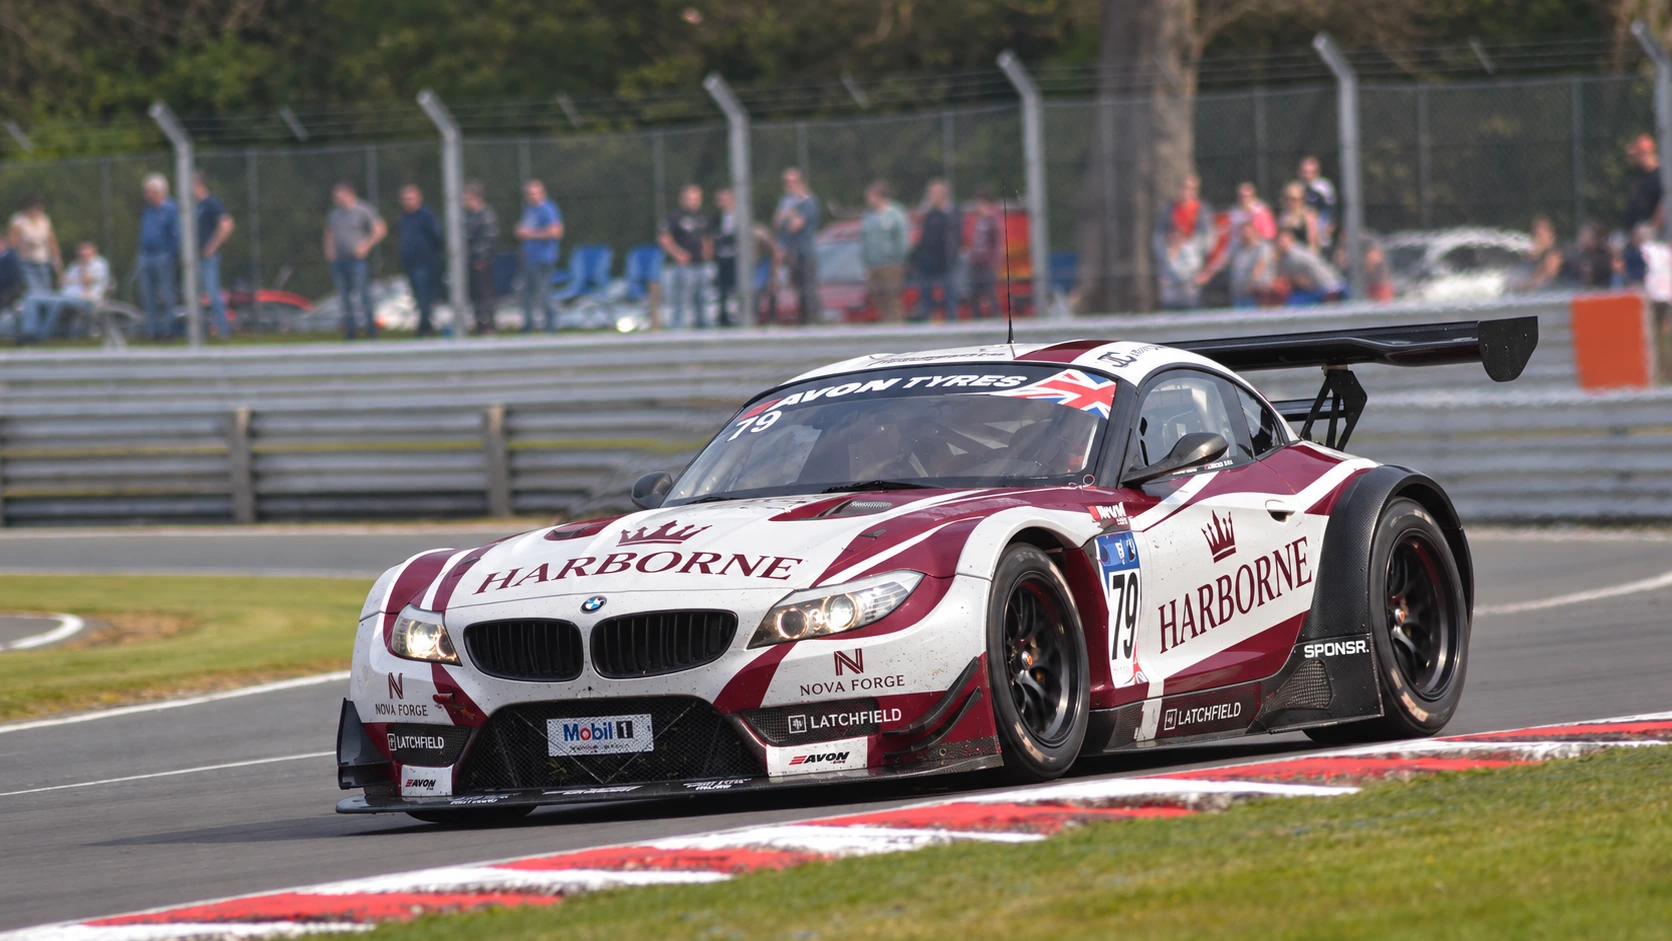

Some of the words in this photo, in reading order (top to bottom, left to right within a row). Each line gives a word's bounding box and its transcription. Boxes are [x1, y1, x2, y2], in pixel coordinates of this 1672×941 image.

[765, 378, 902, 412] AVON
[902, 375, 1028, 389] TYRES
[727, 410, 783, 442] 79
[472, 551, 803, 595] HARBORNE
[1158, 536, 1313, 654] HARBORNE
[1111, 571, 1139, 660] 79
[1304, 639, 1370, 659] SPONSR.
[800, 681, 846, 696] NOVA
[851, 675, 906, 691] FORGE
[375, 703, 396, 716] NOVA
[398, 704, 429, 717] FORGE
[810, 708, 902, 729] LATCHFIELD
[1177, 702, 1242, 725] LATCHFIELD
[563, 721, 614, 741] Mobil
[396, 735, 445, 749] LATCHFIELD
[804, 751, 850, 764] AVON
[412, 779, 436, 788] AVON
